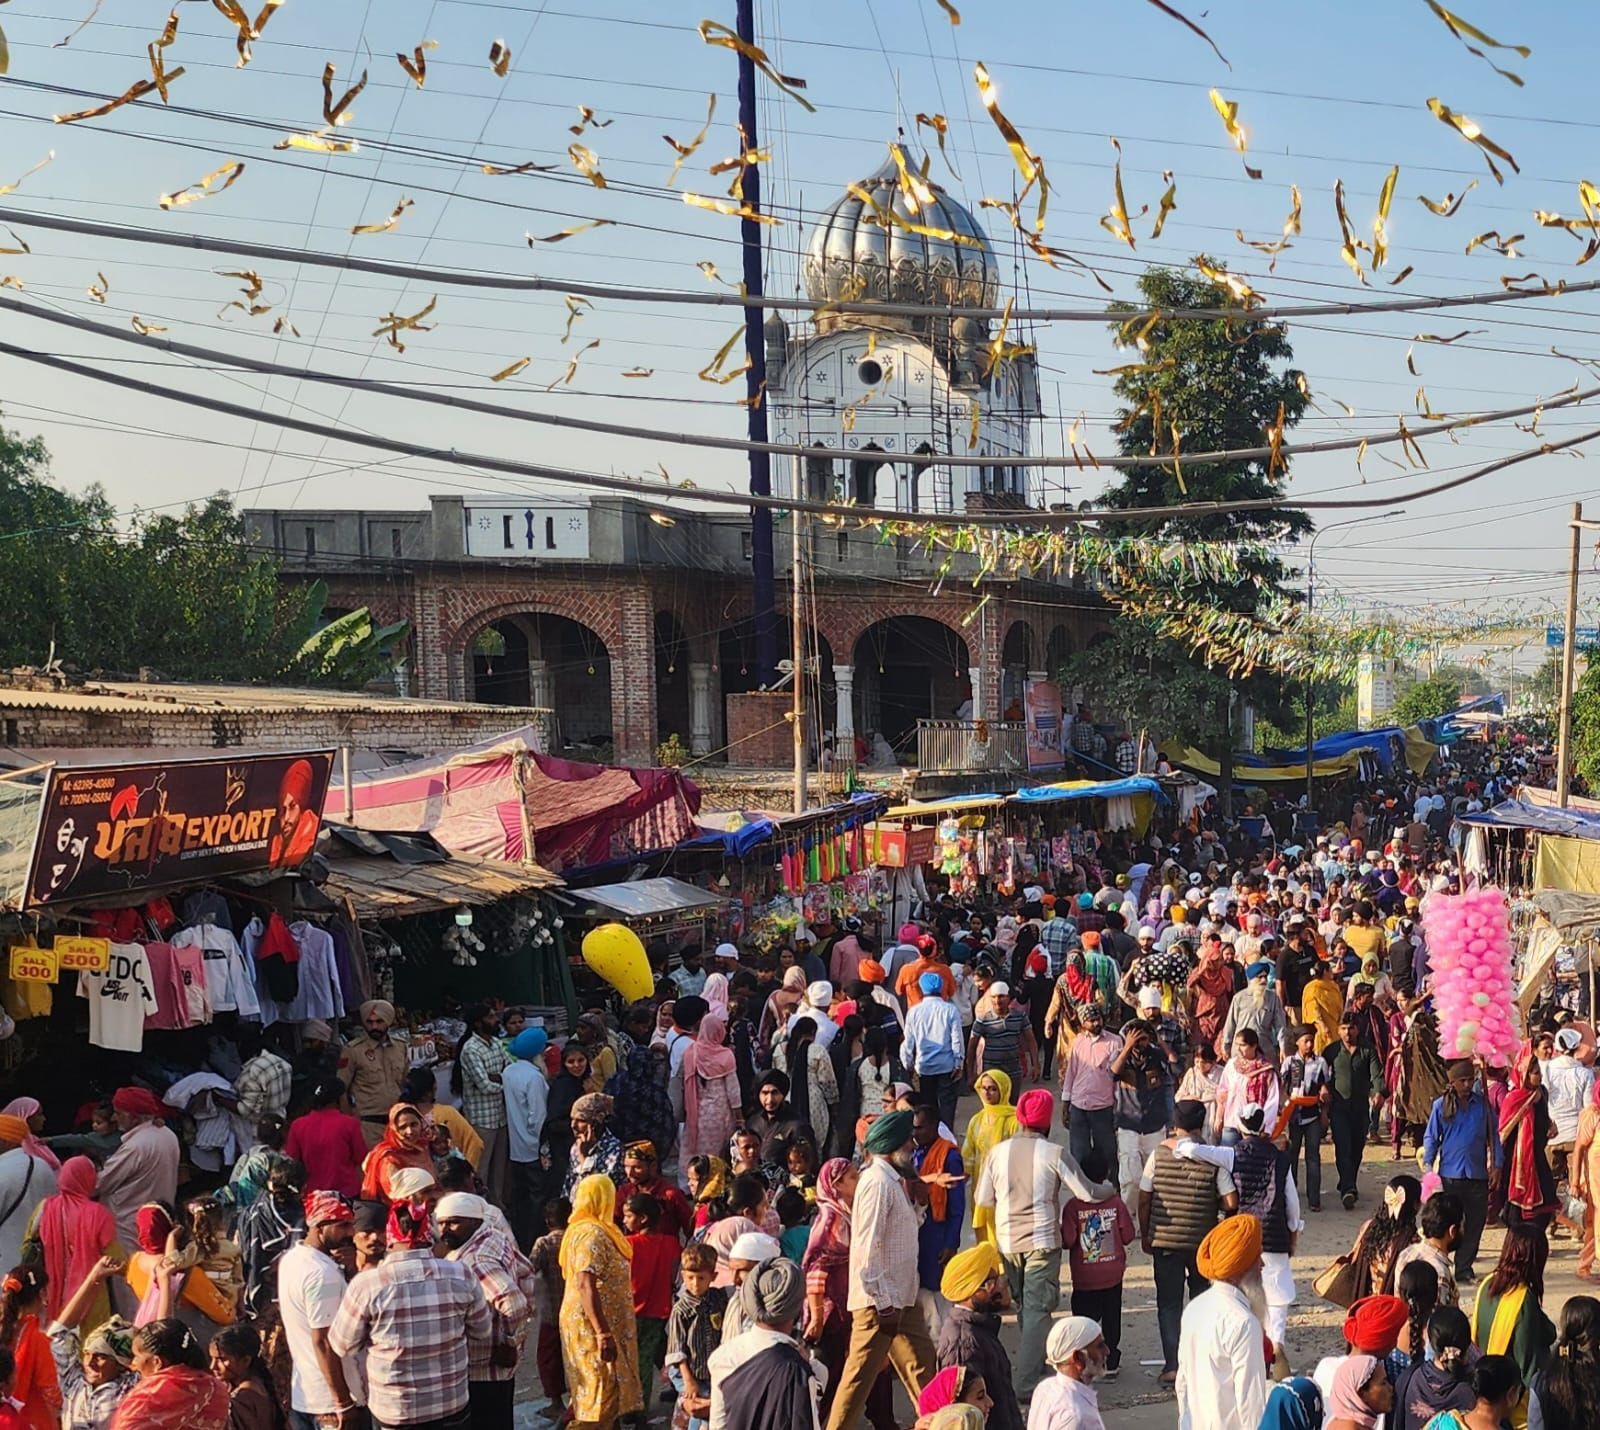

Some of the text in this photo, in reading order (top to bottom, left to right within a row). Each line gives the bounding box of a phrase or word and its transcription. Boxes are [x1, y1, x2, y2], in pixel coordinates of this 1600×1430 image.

[185, 808, 277, 849] EXPORT
[68, 945, 96, 954] SALE
[22, 957, 47, 966] SALE
[63, 954, 101, 967] 500
[18, 965, 51, 979] 300
